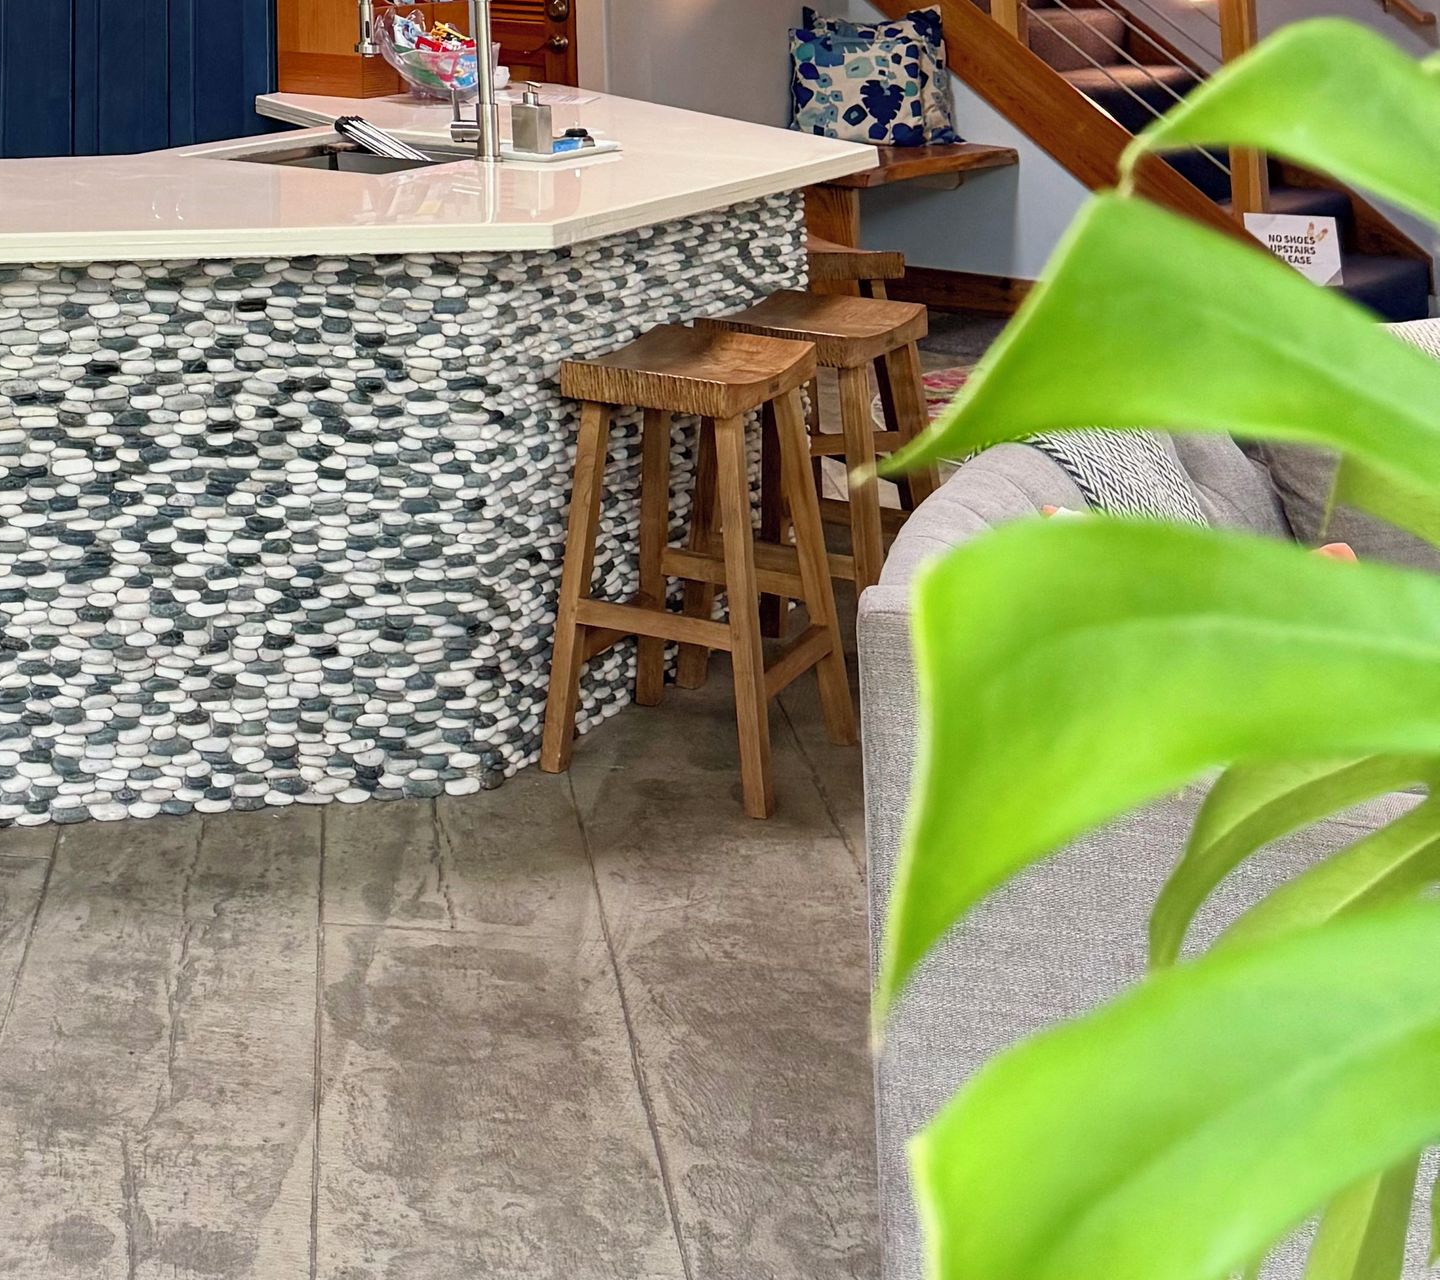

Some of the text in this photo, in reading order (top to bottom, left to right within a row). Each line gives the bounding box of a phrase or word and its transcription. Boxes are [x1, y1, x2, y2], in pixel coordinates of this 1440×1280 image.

[1268, 234, 1316, 245] NO SHOES
[1270, 244, 1316, 255] UPSTAIRS
[1277, 255, 1312, 265] EASE
